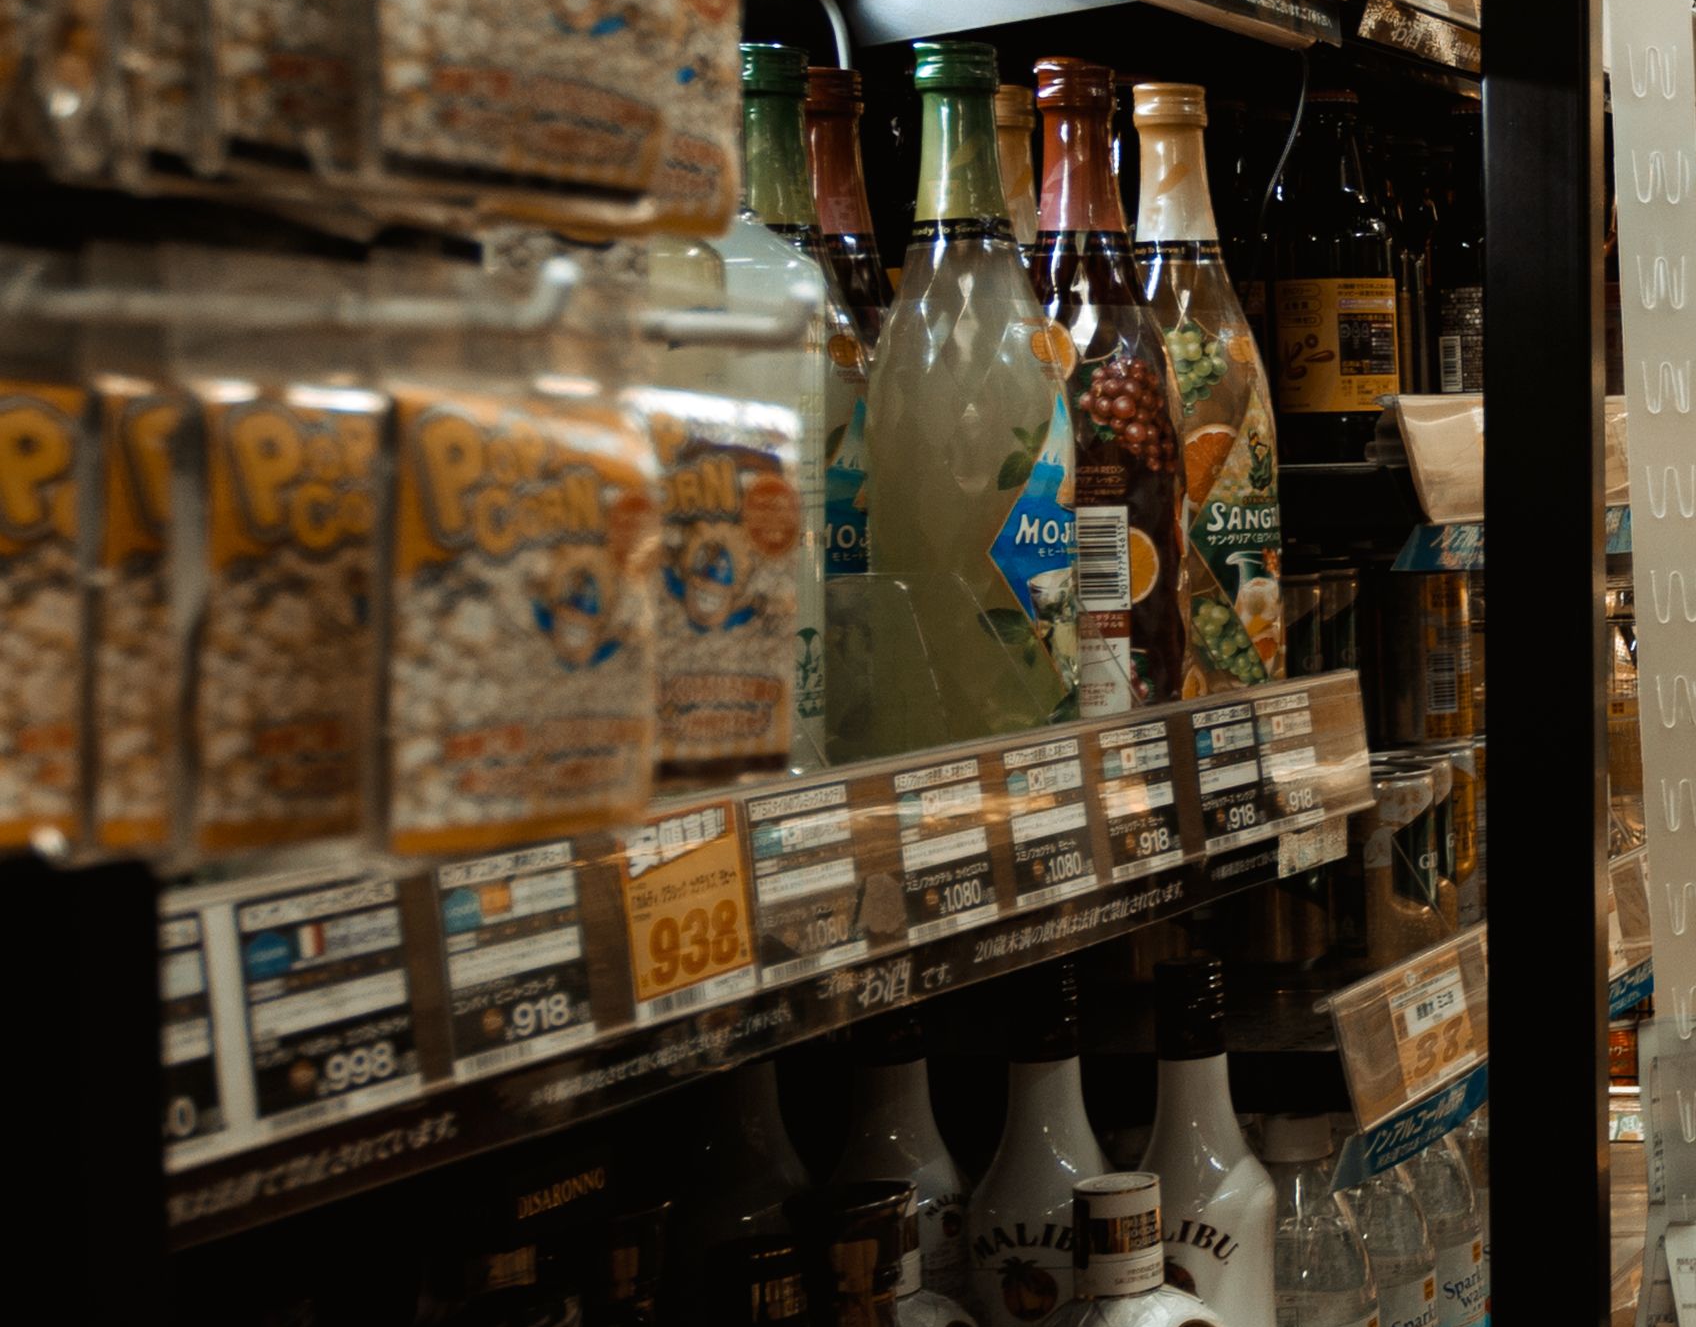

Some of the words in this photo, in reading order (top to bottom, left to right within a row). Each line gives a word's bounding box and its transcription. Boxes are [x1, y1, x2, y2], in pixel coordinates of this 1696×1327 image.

[648, 896, 746, 983] 938
[516, 1166, 606, 1220] DISARONNO
[973, 1219, 1077, 1265] MALIB
